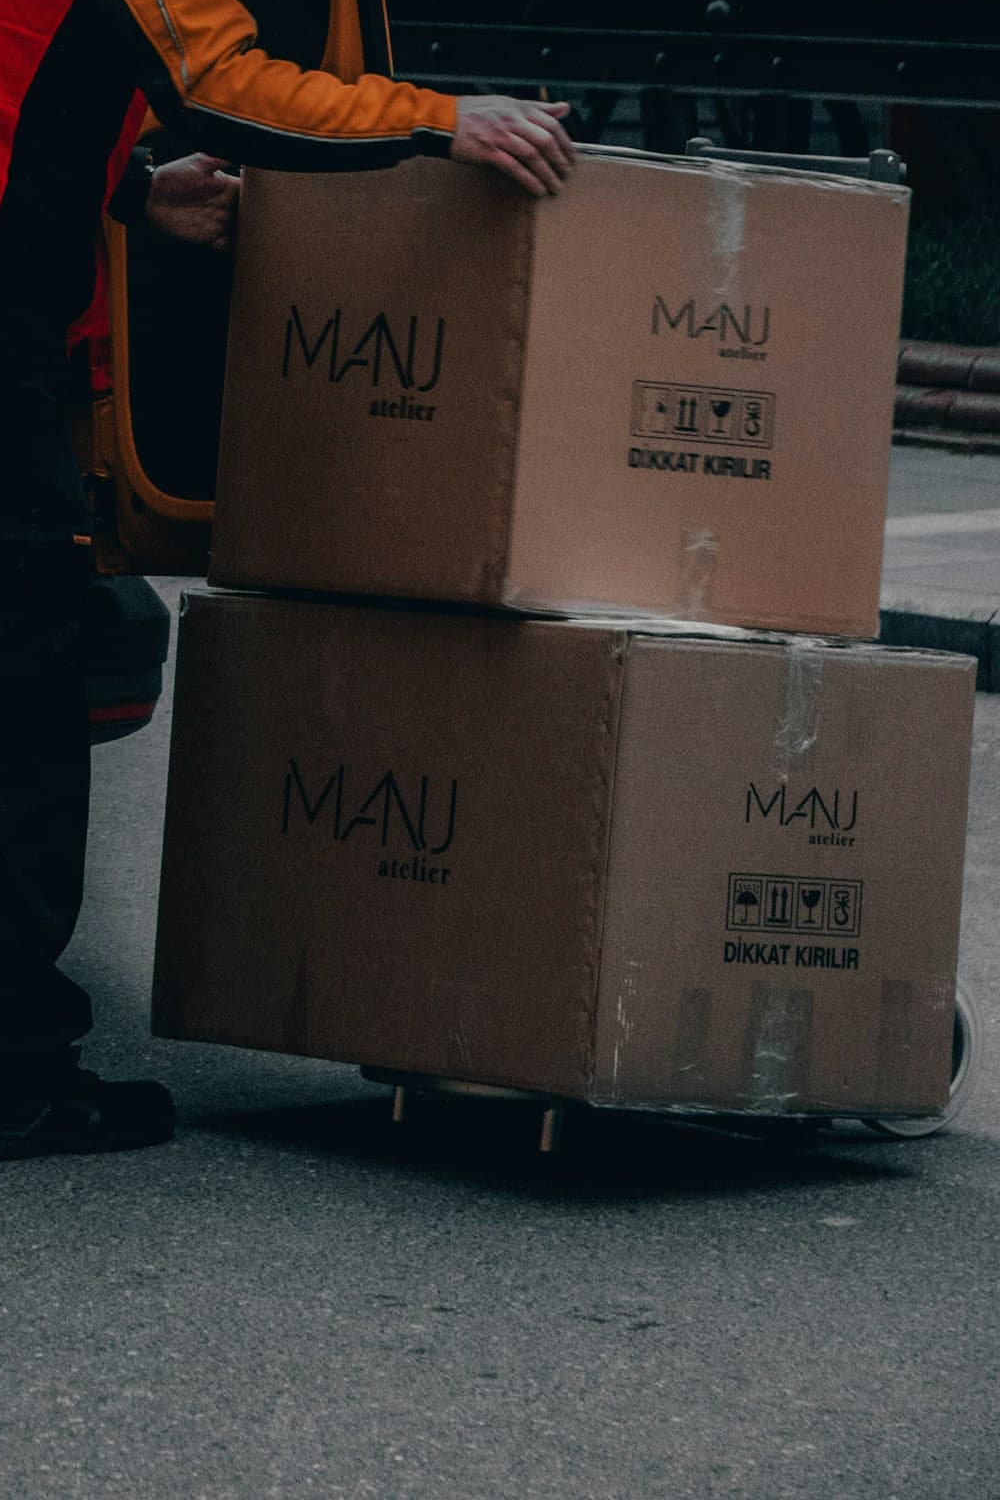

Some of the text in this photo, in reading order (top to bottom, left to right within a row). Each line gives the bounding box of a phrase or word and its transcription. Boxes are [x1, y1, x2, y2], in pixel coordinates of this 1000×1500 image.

[369, 396, 437, 422] atelier
[809, 833, 855, 847] atelier
[378, 857, 450, 885] atelier
[795, 945, 859, 970] KIRILIR
